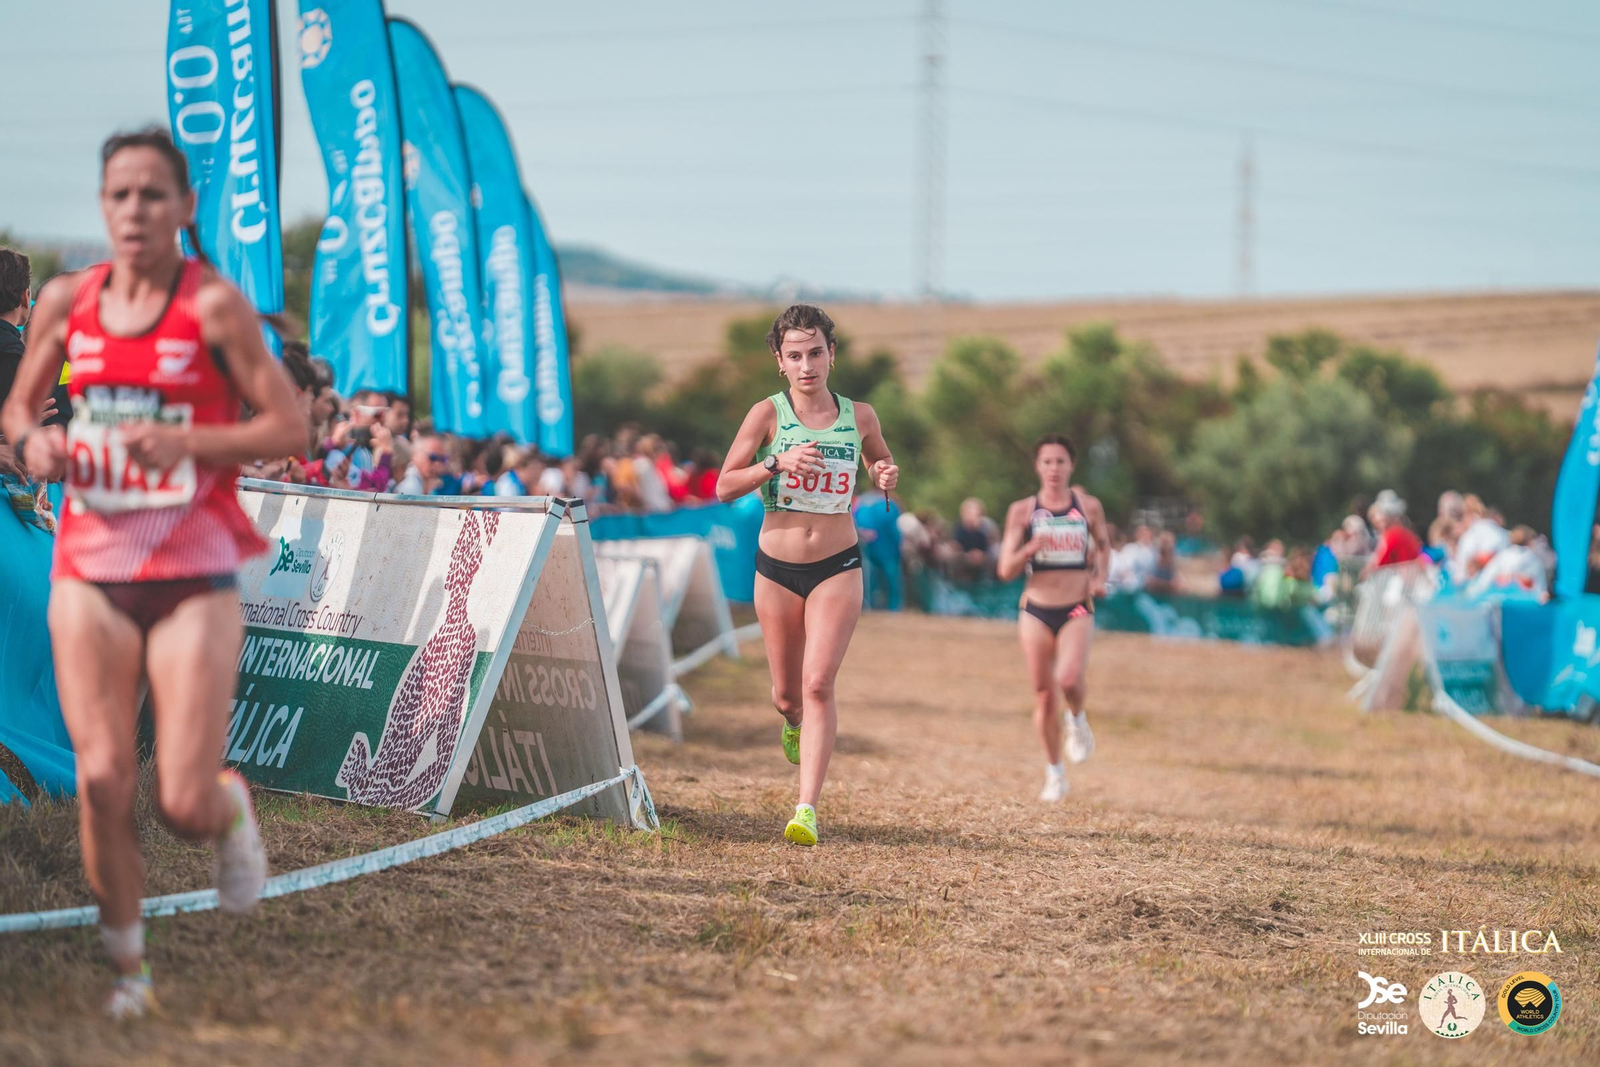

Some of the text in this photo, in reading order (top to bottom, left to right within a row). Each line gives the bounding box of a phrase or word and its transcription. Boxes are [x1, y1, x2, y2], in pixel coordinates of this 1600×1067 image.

[786, 471, 849, 495] 5013
[292, 558, 312, 574] Sevilla
[288, 601, 319, 629] Cross
[317, 604, 363, 639] Country
[235, 634, 381, 690] INTERNACIONAL
